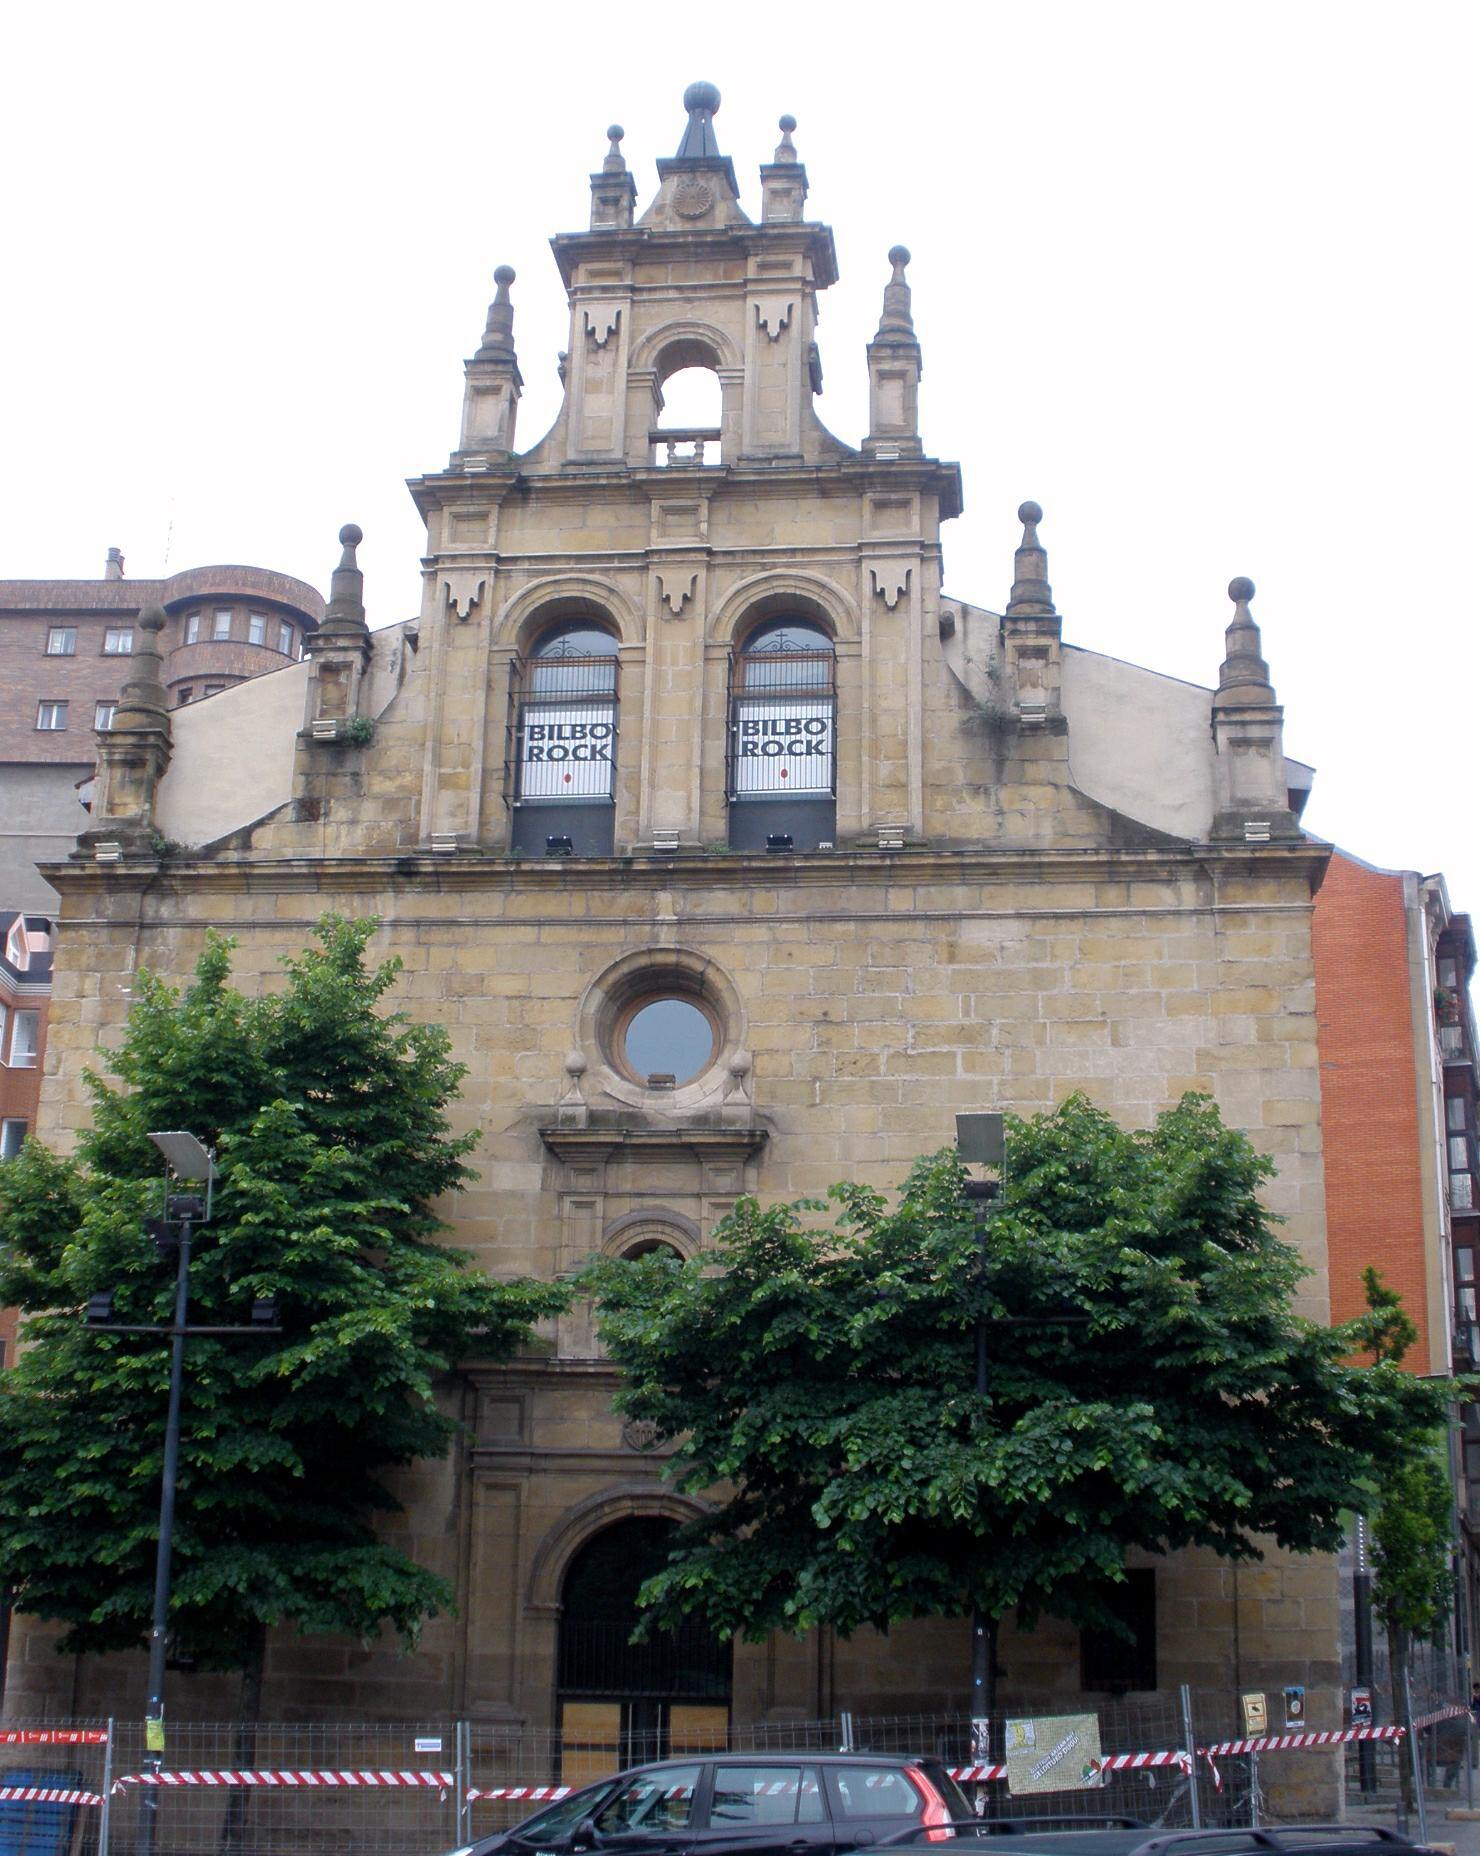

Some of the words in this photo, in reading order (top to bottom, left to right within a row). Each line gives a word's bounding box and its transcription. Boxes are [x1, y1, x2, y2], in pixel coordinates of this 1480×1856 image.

[529, 724, 612, 741] BILBO
[742, 718, 827, 736] BILBO
[528, 743, 610, 761] ROCK
[741, 739, 826, 757] ROCK
